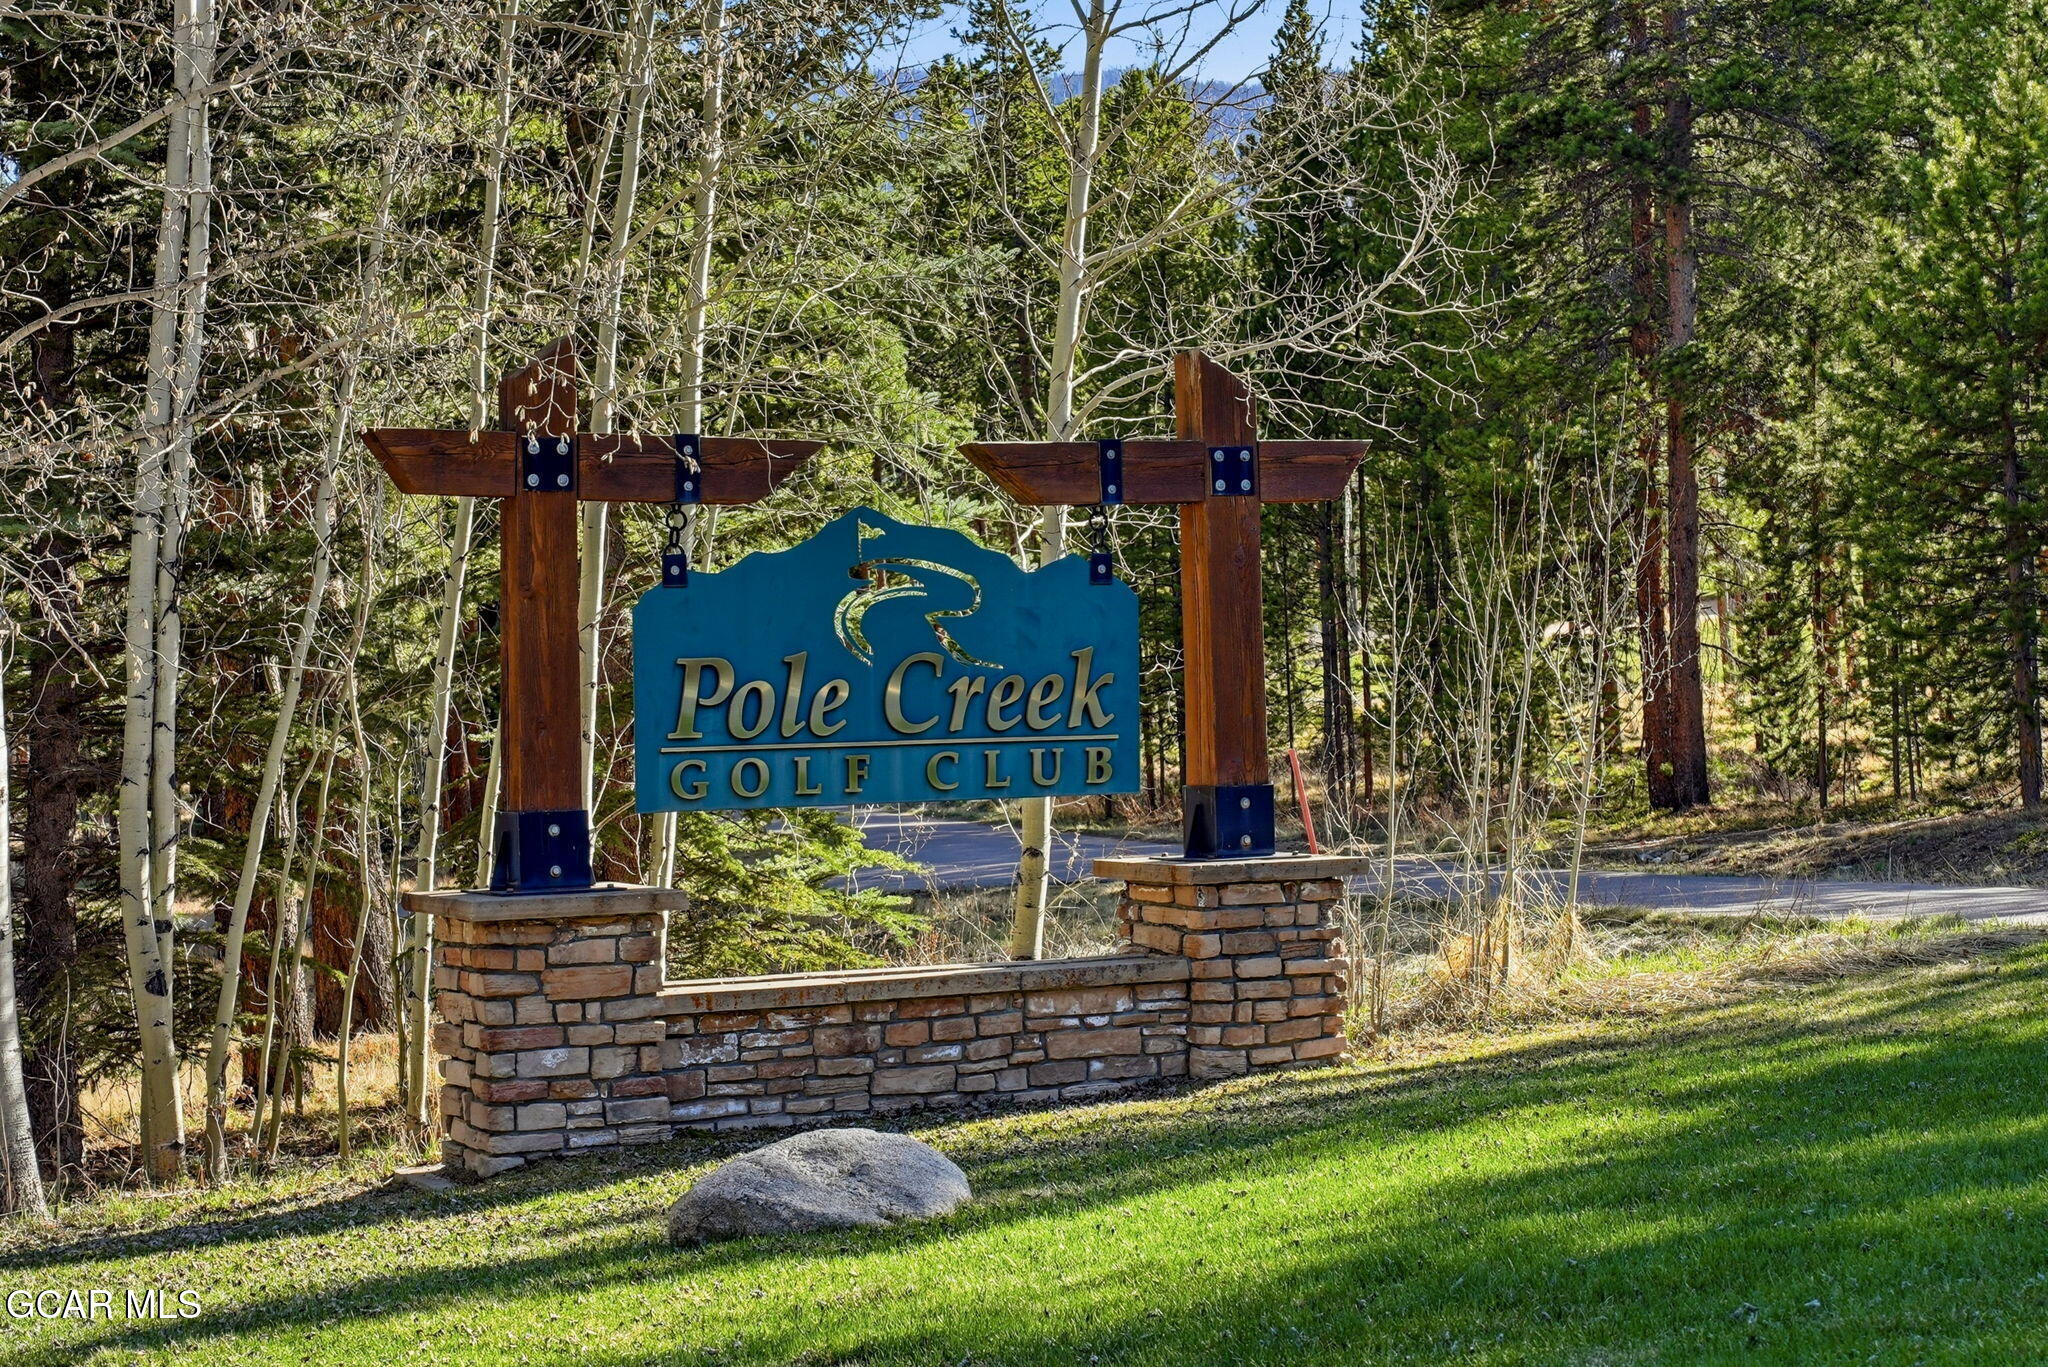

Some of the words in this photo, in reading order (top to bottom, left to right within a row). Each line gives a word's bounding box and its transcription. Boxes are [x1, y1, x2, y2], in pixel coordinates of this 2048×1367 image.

[667, 651, 851, 740] Pole
[884, 646, 1115, 735] Creek
[670, 754, 871, 800] GOLF
[926, 747, 1114, 791] CLUB
